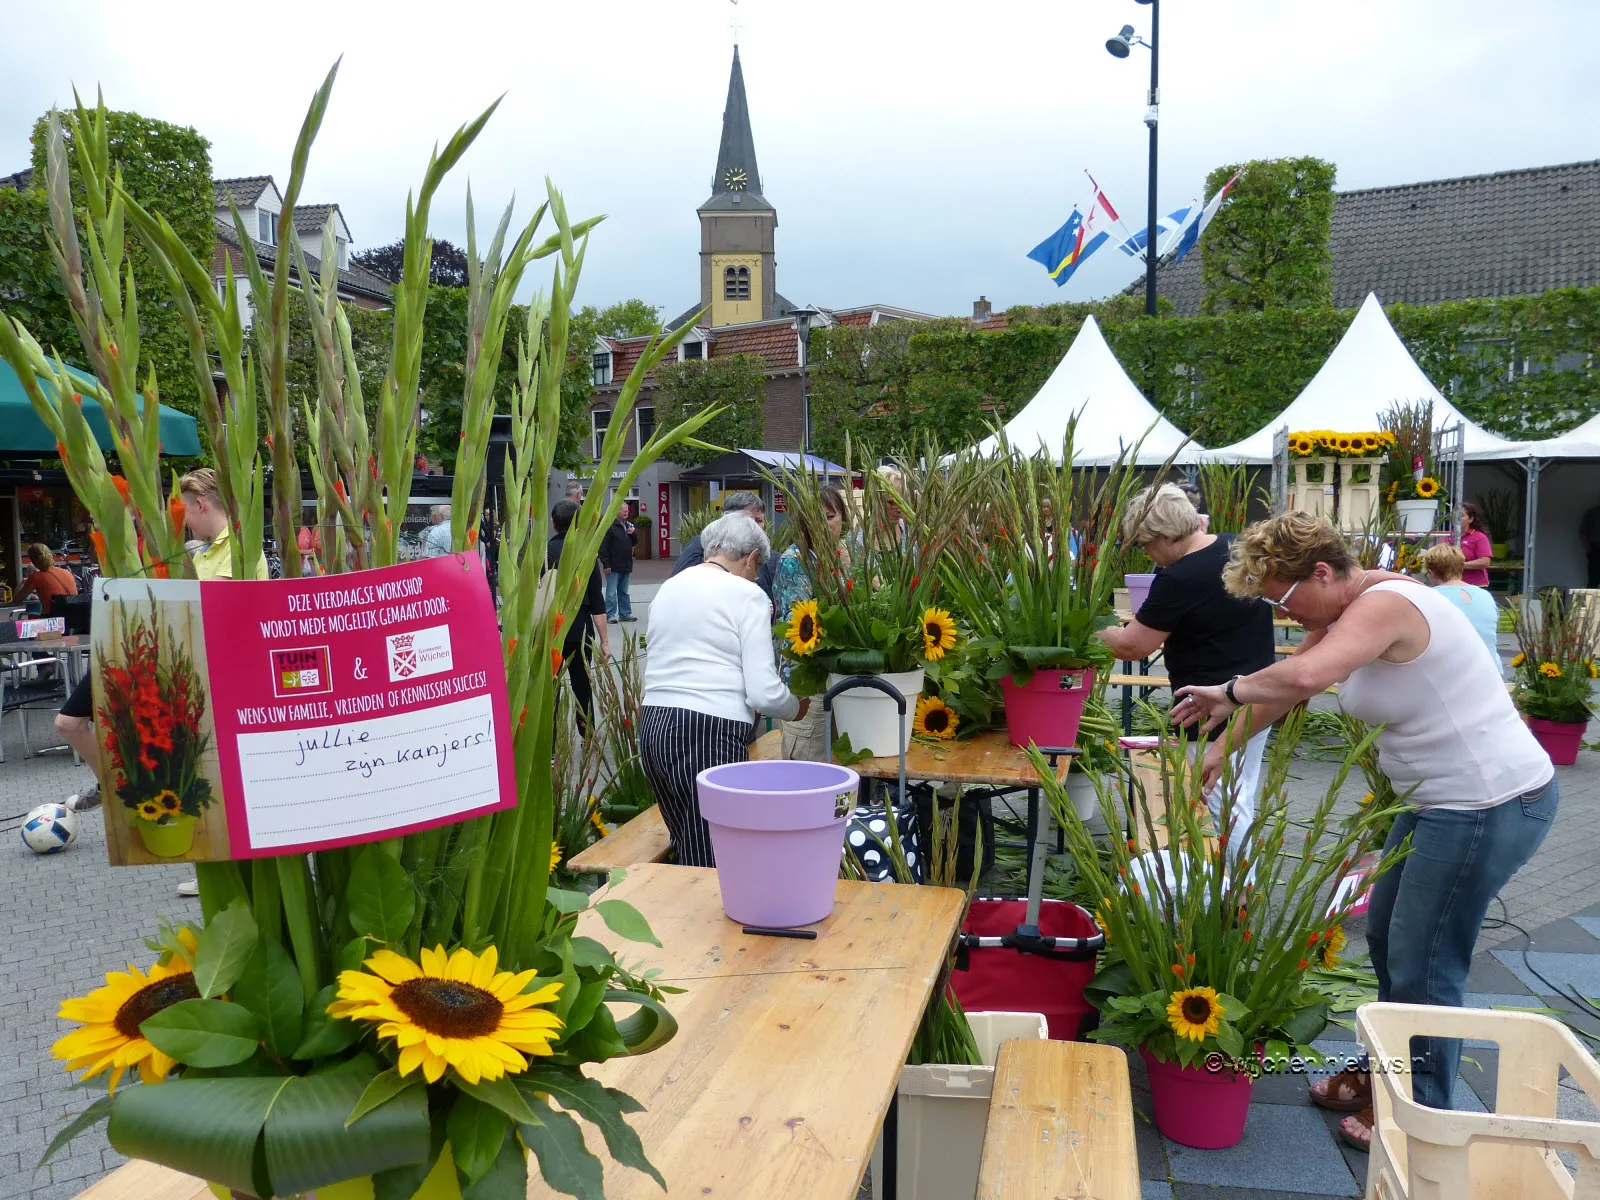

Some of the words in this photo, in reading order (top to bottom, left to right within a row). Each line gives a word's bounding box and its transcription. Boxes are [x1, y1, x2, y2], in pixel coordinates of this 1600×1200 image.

[660, 491, 668, 551] SALDI
[288, 593, 311, 612] DEZE
[312, 585, 375, 610] VIERDAAGSE
[376, 576, 423, 602] WORKSHOP
[260, 619, 298, 639] WORDT
[299, 617, 327, 636] MEDE
[328, 609, 378, 633] MOGELIJK
[379, 601, 423, 626] GEMAAKT
[424, 596, 450, 617] DOOR:
[277, 651, 317, 665] TUIN
[418, 645, 442, 654] Gemeente
[419, 650, 450, 662] Wijchen
[353, 657, 369, 680] &
[237, 707, 267, 725] WENS
[268, 705, 286, 723] UW
[288, 701, 333, 721] FAMILIE,
[334, 693, 384, 716] VRIENDEN
[388, 690, 399, 708] OF
[401, 679, 452, 705] KENNISSEN
[452, 671, 487, 694] SUCCES!
